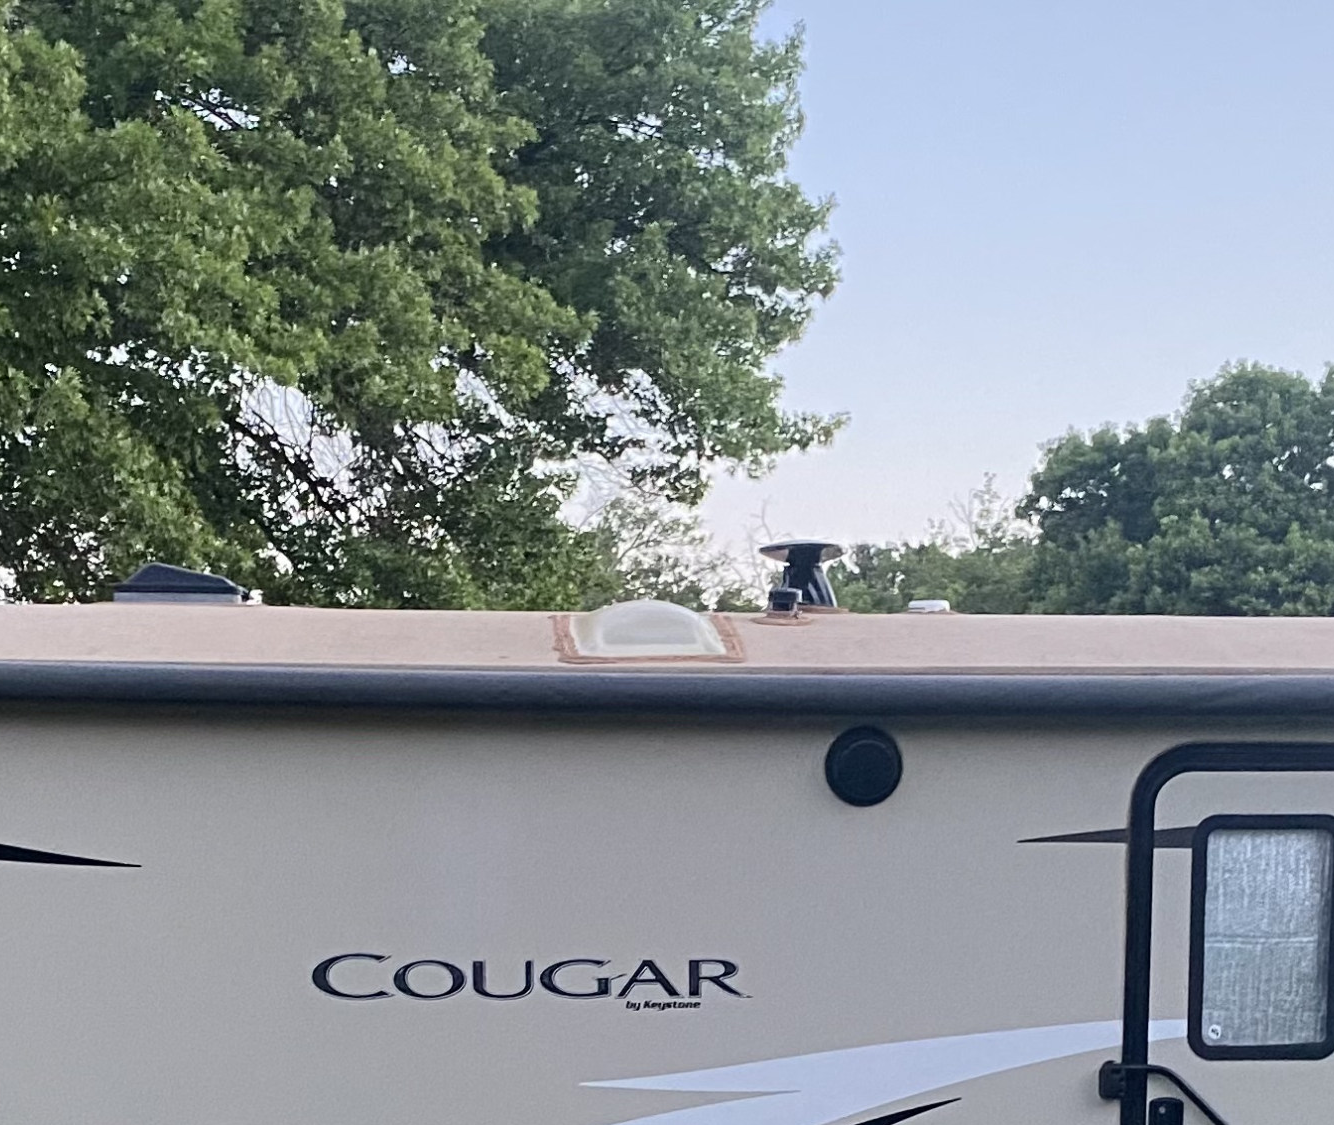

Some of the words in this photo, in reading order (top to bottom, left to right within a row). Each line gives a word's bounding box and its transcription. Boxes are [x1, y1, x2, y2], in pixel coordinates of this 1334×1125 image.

[311, 953, 753, 999] COUGAR
[626, 1000, 641, 1011] by
[643, 1000, 701, 1011] Keystone
